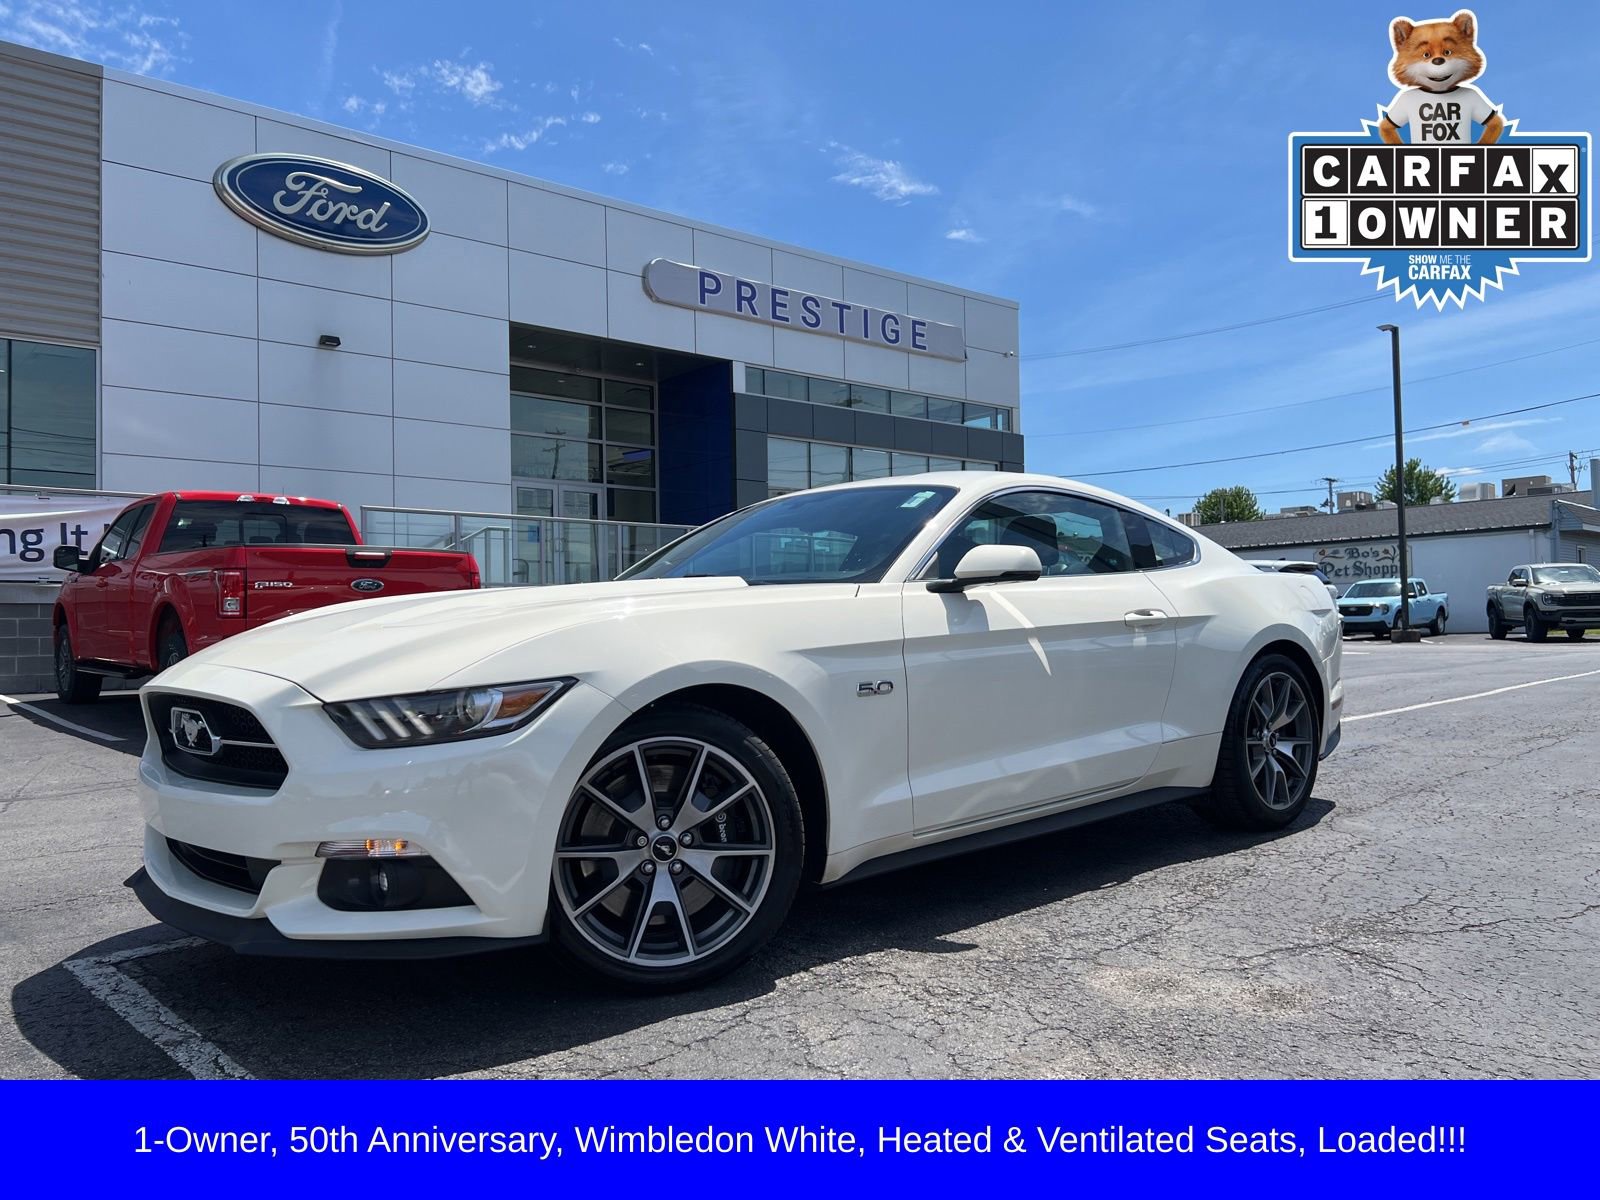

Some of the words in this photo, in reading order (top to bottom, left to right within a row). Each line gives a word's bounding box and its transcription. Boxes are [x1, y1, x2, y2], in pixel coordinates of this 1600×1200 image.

[272, 171, 391, 233] Ford
[698, 270, 928, 351] PRESTIGE
[1344, 547, 1380, 560] Bo's
[1319, 561, 1350, 578] Pet
[1352, 560, 1401, 578] Shopp
[856, 680, 894, 697] 5.0
